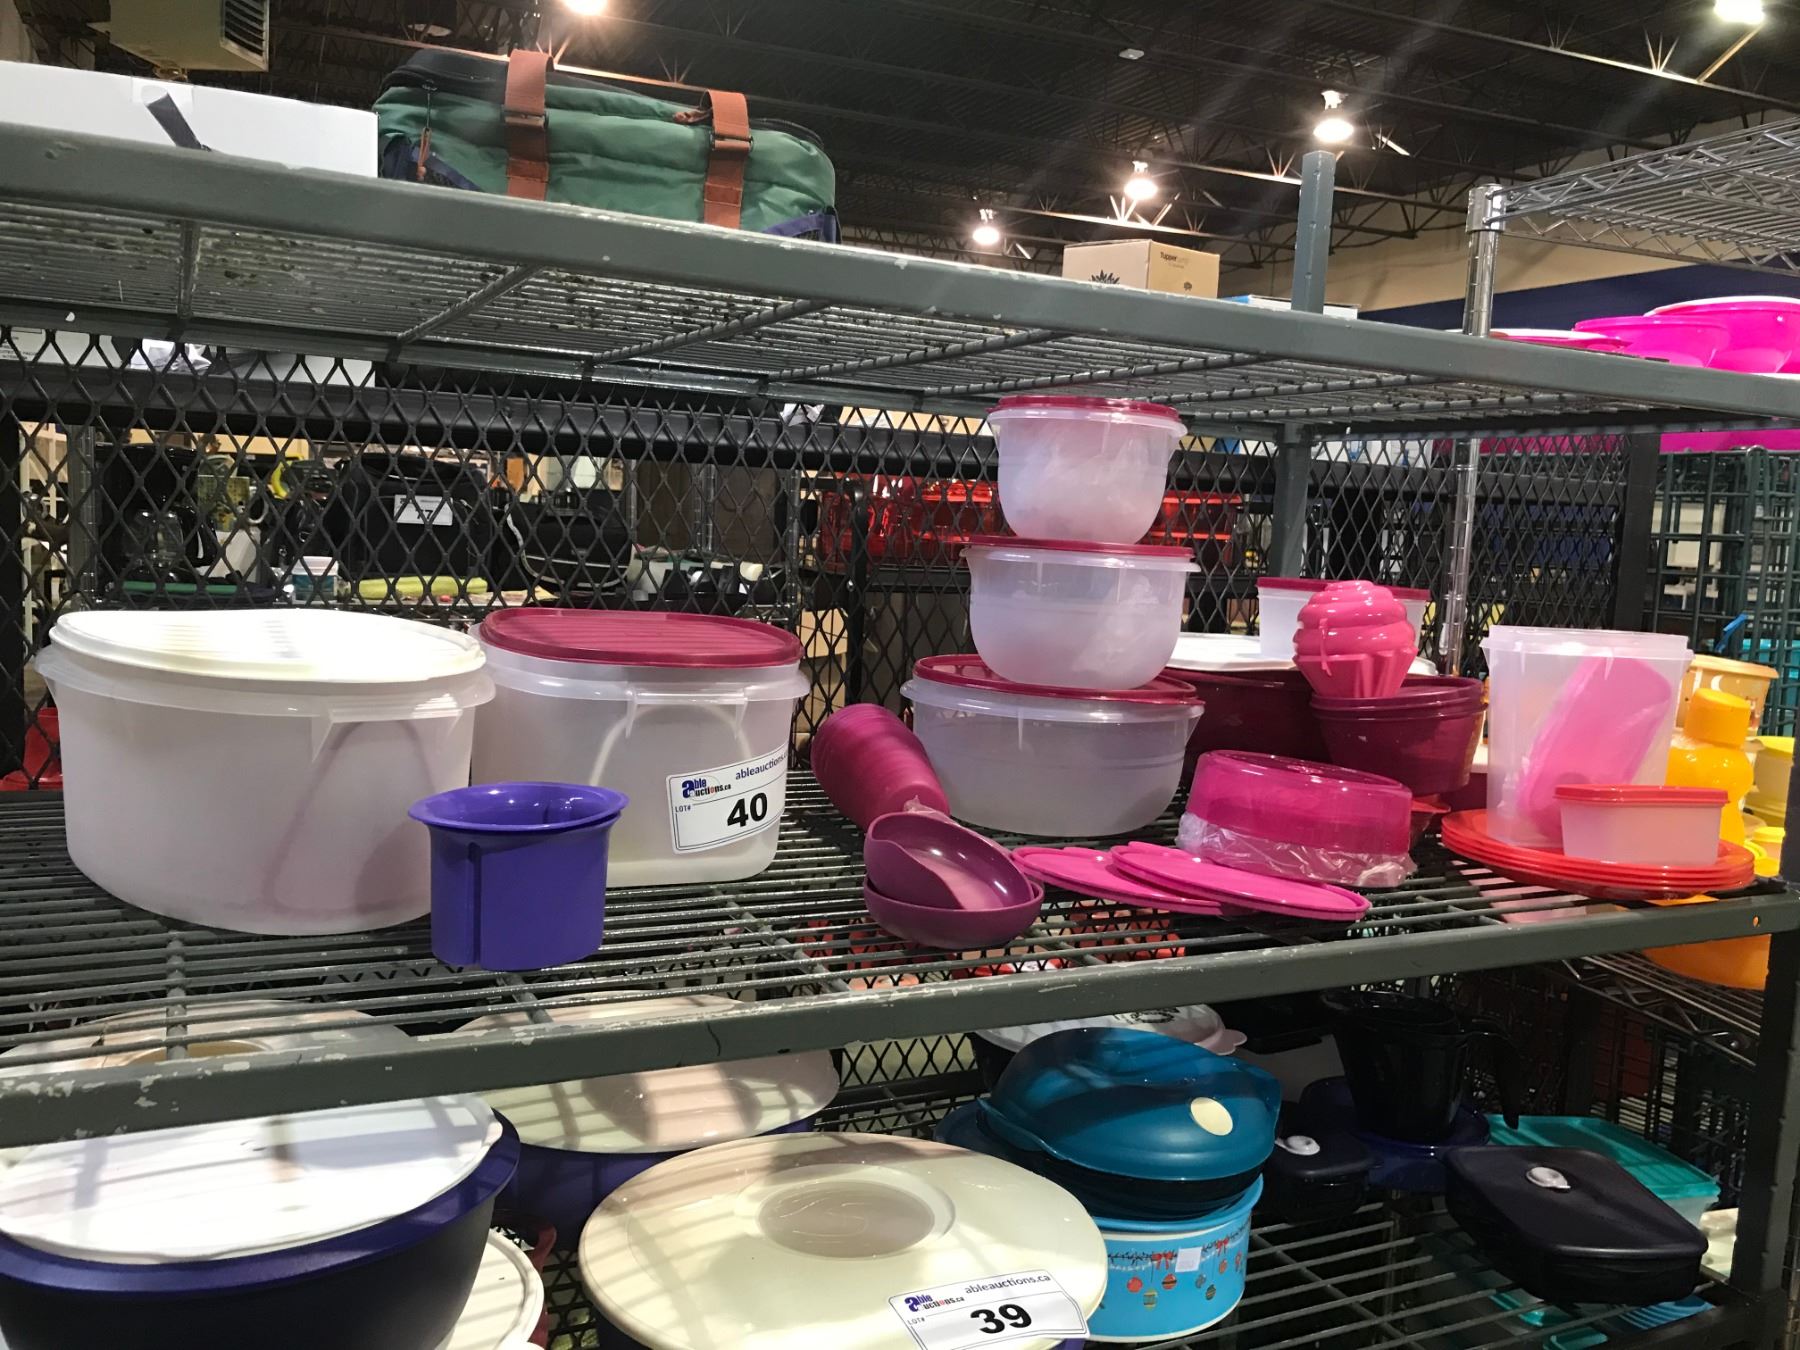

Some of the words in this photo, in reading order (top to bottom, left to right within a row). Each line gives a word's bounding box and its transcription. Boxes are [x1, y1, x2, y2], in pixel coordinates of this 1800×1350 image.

[675, 805, 691, 813] LOT#
[727, 792, 768, 827] 40
[965, 1274, 1050, 1294] ableauctions.ca
[907, 1317, 925, 1326] LOT#
[970, 1304, 1031, 1334] 39
